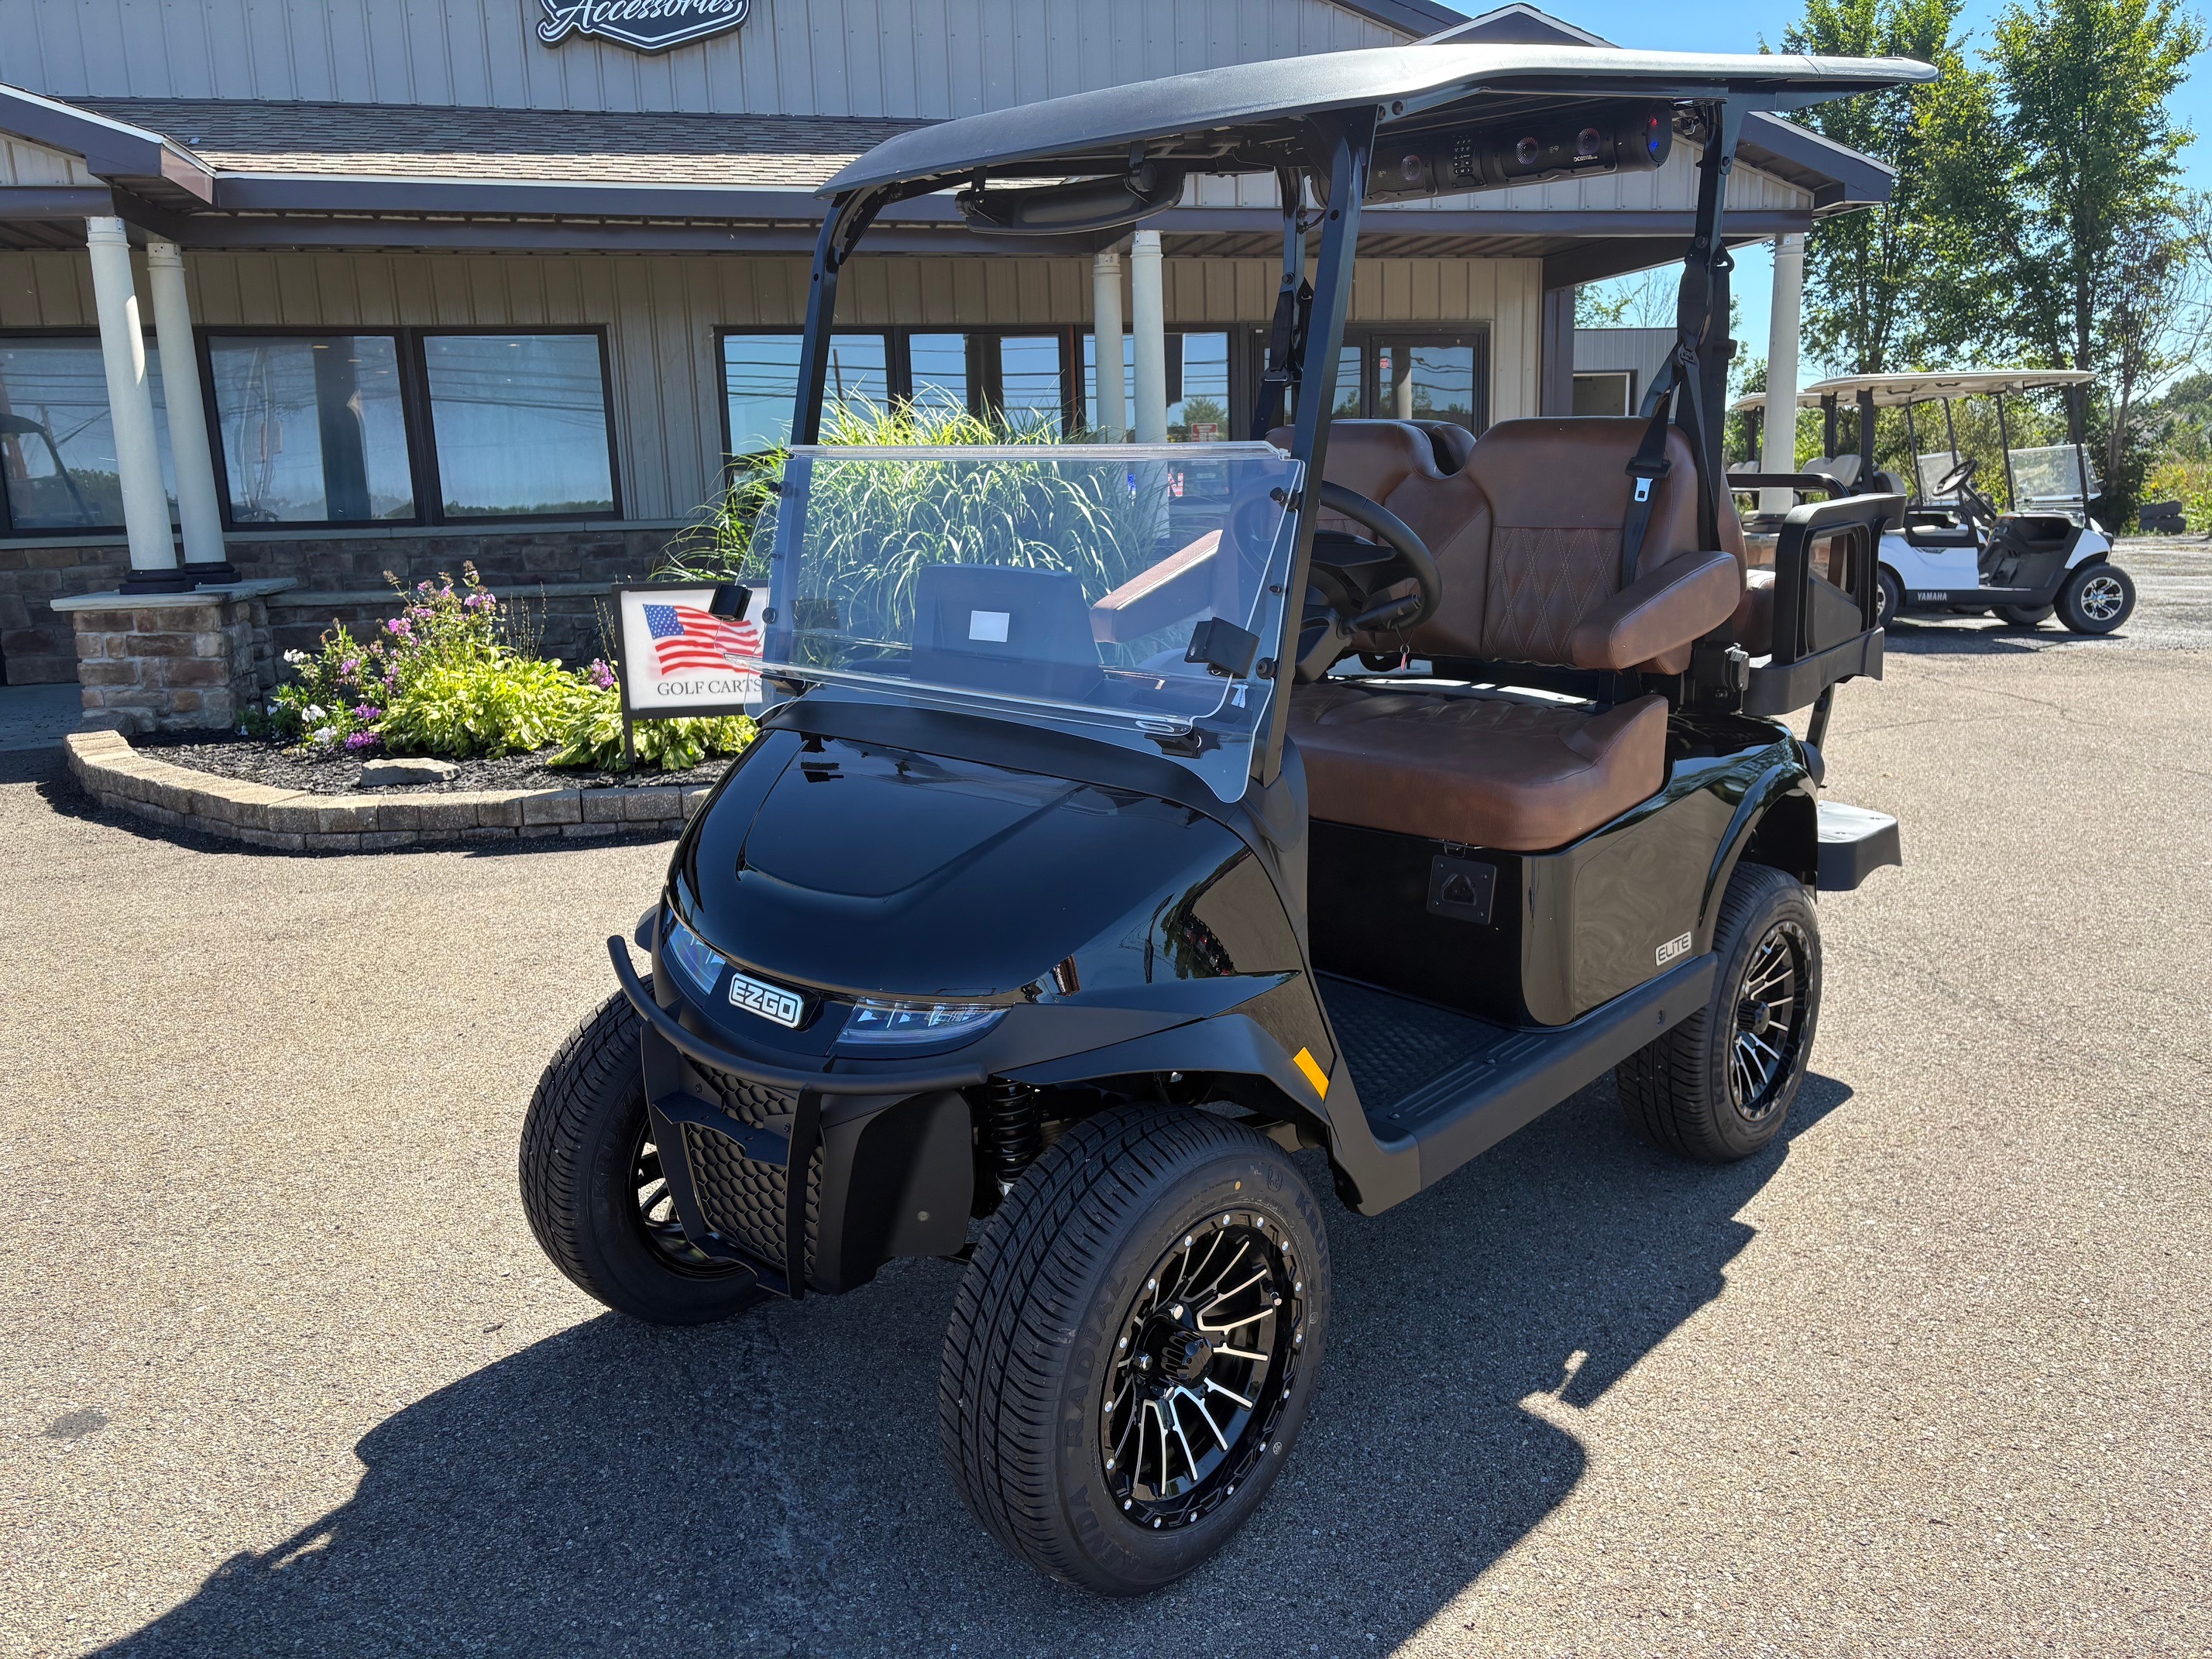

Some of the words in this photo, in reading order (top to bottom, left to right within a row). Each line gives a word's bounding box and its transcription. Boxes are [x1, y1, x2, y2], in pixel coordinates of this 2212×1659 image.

[1917, 592, 1947, 601] YAMAHA
[658, 682, 704, 696] GOLF
[708, 678, 762, 694] CARTS
[732, 980, 796, 1022] EZGO
[591, 1072, 644, 1200] KRUIZ
[1063, 1274, 1128, 1447] RADIAL
